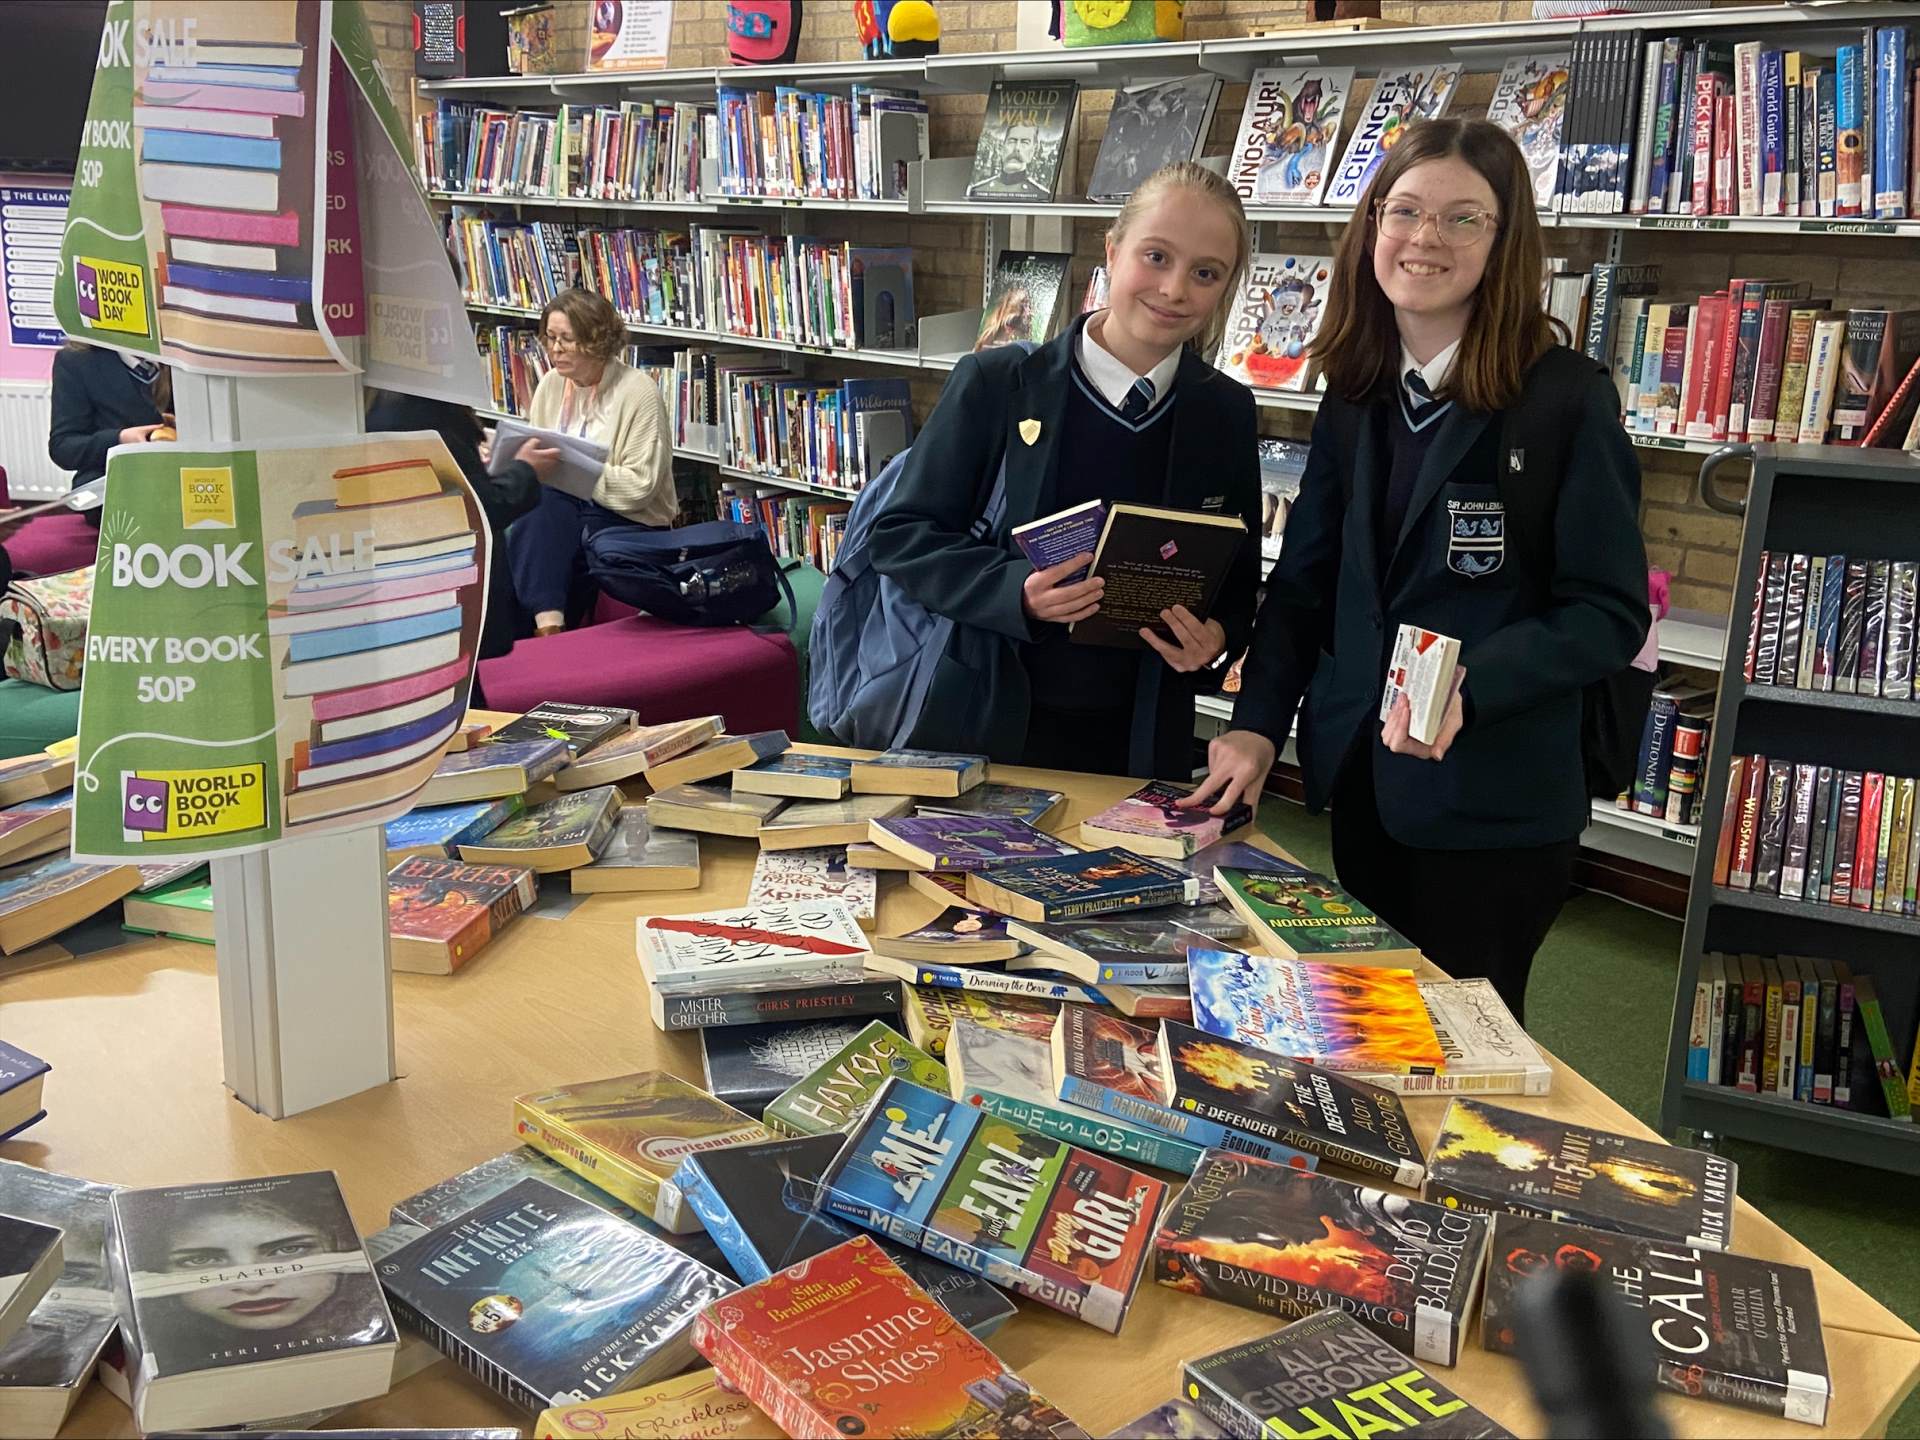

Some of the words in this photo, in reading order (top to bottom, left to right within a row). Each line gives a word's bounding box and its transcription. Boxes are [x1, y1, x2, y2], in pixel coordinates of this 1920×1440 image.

[135, 18, 198, 68] SALE
[1769, 61, 1778, 75] The
[1000, 90, 1060, 106] WORLD
[1697, 80, 1711, 117] PICK
[1767, 75, 1779, 112] World
[92, 121, 131, 149] BOOK
[1000, 110, 1038, 127] WAR
[1044, 110, 1052, 127] I
[1653, 103, 1672, 157] Walks
[1767, 113, 1778, 149] Guide
[1237, 81, 1281, 199] DINOSAUR!
[1337, 81, 1398, 198] SCIENCE!
[81, 160, 103, 188] 50P
[14, 191, 34, 201] THE
[1826, 223, 1868, 233] General
[97, 268, 139, 289] WORLD
[101, 287, 133, 306] BOOK
[103, 303, 124, 322] DAY
[1233, 265, 1275, 348] SPACE!
[1589, 268, 1610, 345] MINERALS
[1848, 320, 1885, 328] OXFORD
[1847, 331, 1882, 341] MUSIC
[188, 483, 225, 494] BOOK
[194, 494, 220, 504] DAY
[1447, 500, 1461, 510] SIR
[1461, 501, 1485, 511] JOHN
[112, 542, 259, 589] BOOK
[268, 530, 376, 582] SALE
[88, 635, 164, 663] EVERY
[164, 632, 264, 664] BOOK
[137, 675, 196, 703] 50P
[1644, 714, 1668, 793] DICTIONARY
[172, 772, 257, 794] WORLD
[176, 791, 241, 811] BOOK
[177, 811, 219, 829] DAY
[1738, 796, 1756, 861] WILDSPARK
[401, 858, 523, 886] SEEKER
[1064, 902, 1084, 917] TERRY
[1085, 897, 1123, 914] PRATCHETT
[1270, 916, 1377, 928] ARMAGEDDON
[969, 974, 1011, 992] Dreaming
[1010, 977, 1023, 992] the
[1023, 980, 1048, 994] Bear
[1297, 961, 1321, 1017] MORPURGO
[670, 1011, 729, 1028] CREECHER
[680, 998, 724, 1014] MISTER
[757, 999, 790, 1012] CHRIS
[795, 995, 856, 1010] PRIESTLEY
[921, 988, 951, 1032] SOPHIE
[1074, 1008, 1084, 1050] GOLDING
[1309, 1017, 1328, 1057] MICHAEL
[779, 1040, 802, 1069] THE
[1072, 1050, 1084, 1077] JULIA
[789, 1037, 897, 1128] HAVOC
[1294, 1083, 1315, 1107] THE
[1403, 1074, 1433, 1091] BLOOD
[1434, 1074, 1454, 1091] RED
[1112, 1095, 1189, 1133] PENDRAGON
[1310, 1072, 1347, 1136] DEFENDER
[1350, 1097, 1378, 1134] Alan
[1079, 1127, 1142, 1154] FOWL
[1179, 1096, 1205, 1115] TE
[1207, 1107, 1279, 1138] DEFENDER
[1281, 1127, 1322, 1152] Alan
[1324, 1143, 1395, 1176] Gibbons
[1373, 1092, 1412, 1157] Gibbons
[870, 1122, 956, 1204] ME
[1229, 1133, 1272, 1160] GOLDING
[959, 1140, 1048, 1234] EARL
[1703, 1155, 1728, 1206] YANCEY
[449, 1218, 487, 1241] THE
[831, 1201, 870, 1218] ANDREWS
[868, 1210, 906, 1238] ME
[904, 1228, 923, 1243] and
[921, 1234, 984, 1272] EARL
[1074, 1189, 1134, 1260] GIRL
[1700, 1208, 1726, 1243] RICK
[419, 1202, 559, 1287] INFINITE
[495, 1240, 533, 1265] SEA
[1384, 1218, 1433, 1283] DAVID
[1414, 1211, 1473, 1311] BALDACCI
[199, 1262, 306, 1286] SLATED
[790, 1280, 825, 1300] Sita
[767, 1272, 864, 1324] Brahmachari
[1217, 1264, 1289, 1297] DAVID
[1295, 1285, 1412, 1332] BALDACCI
[1649, 1248, 1710, 1355] CALL
[1731, 1287, 1750, 1332] PEADAR
[208, 1346, 261, 1361] TERI
[272, 1333, 339, 1351] TERRY
[580, 1357, 602, 1374] NEW
[600, 1338, 624, 1361] YORK
[782, 1304, 933, 1376] Jasmine
[1276, 1326, 1376, 1379] ALAN
[437, 1326, 515, 1403] INFINITE
[568, 1357, 633, 1402] RICK
[841, 1340, 943, 1393] Skies
[1247, 1348, 1411, 1415] GIBBONS
[635, 1399, 751, 1432] Reckless
[1260, 1369, 1469, 1440] HATE
